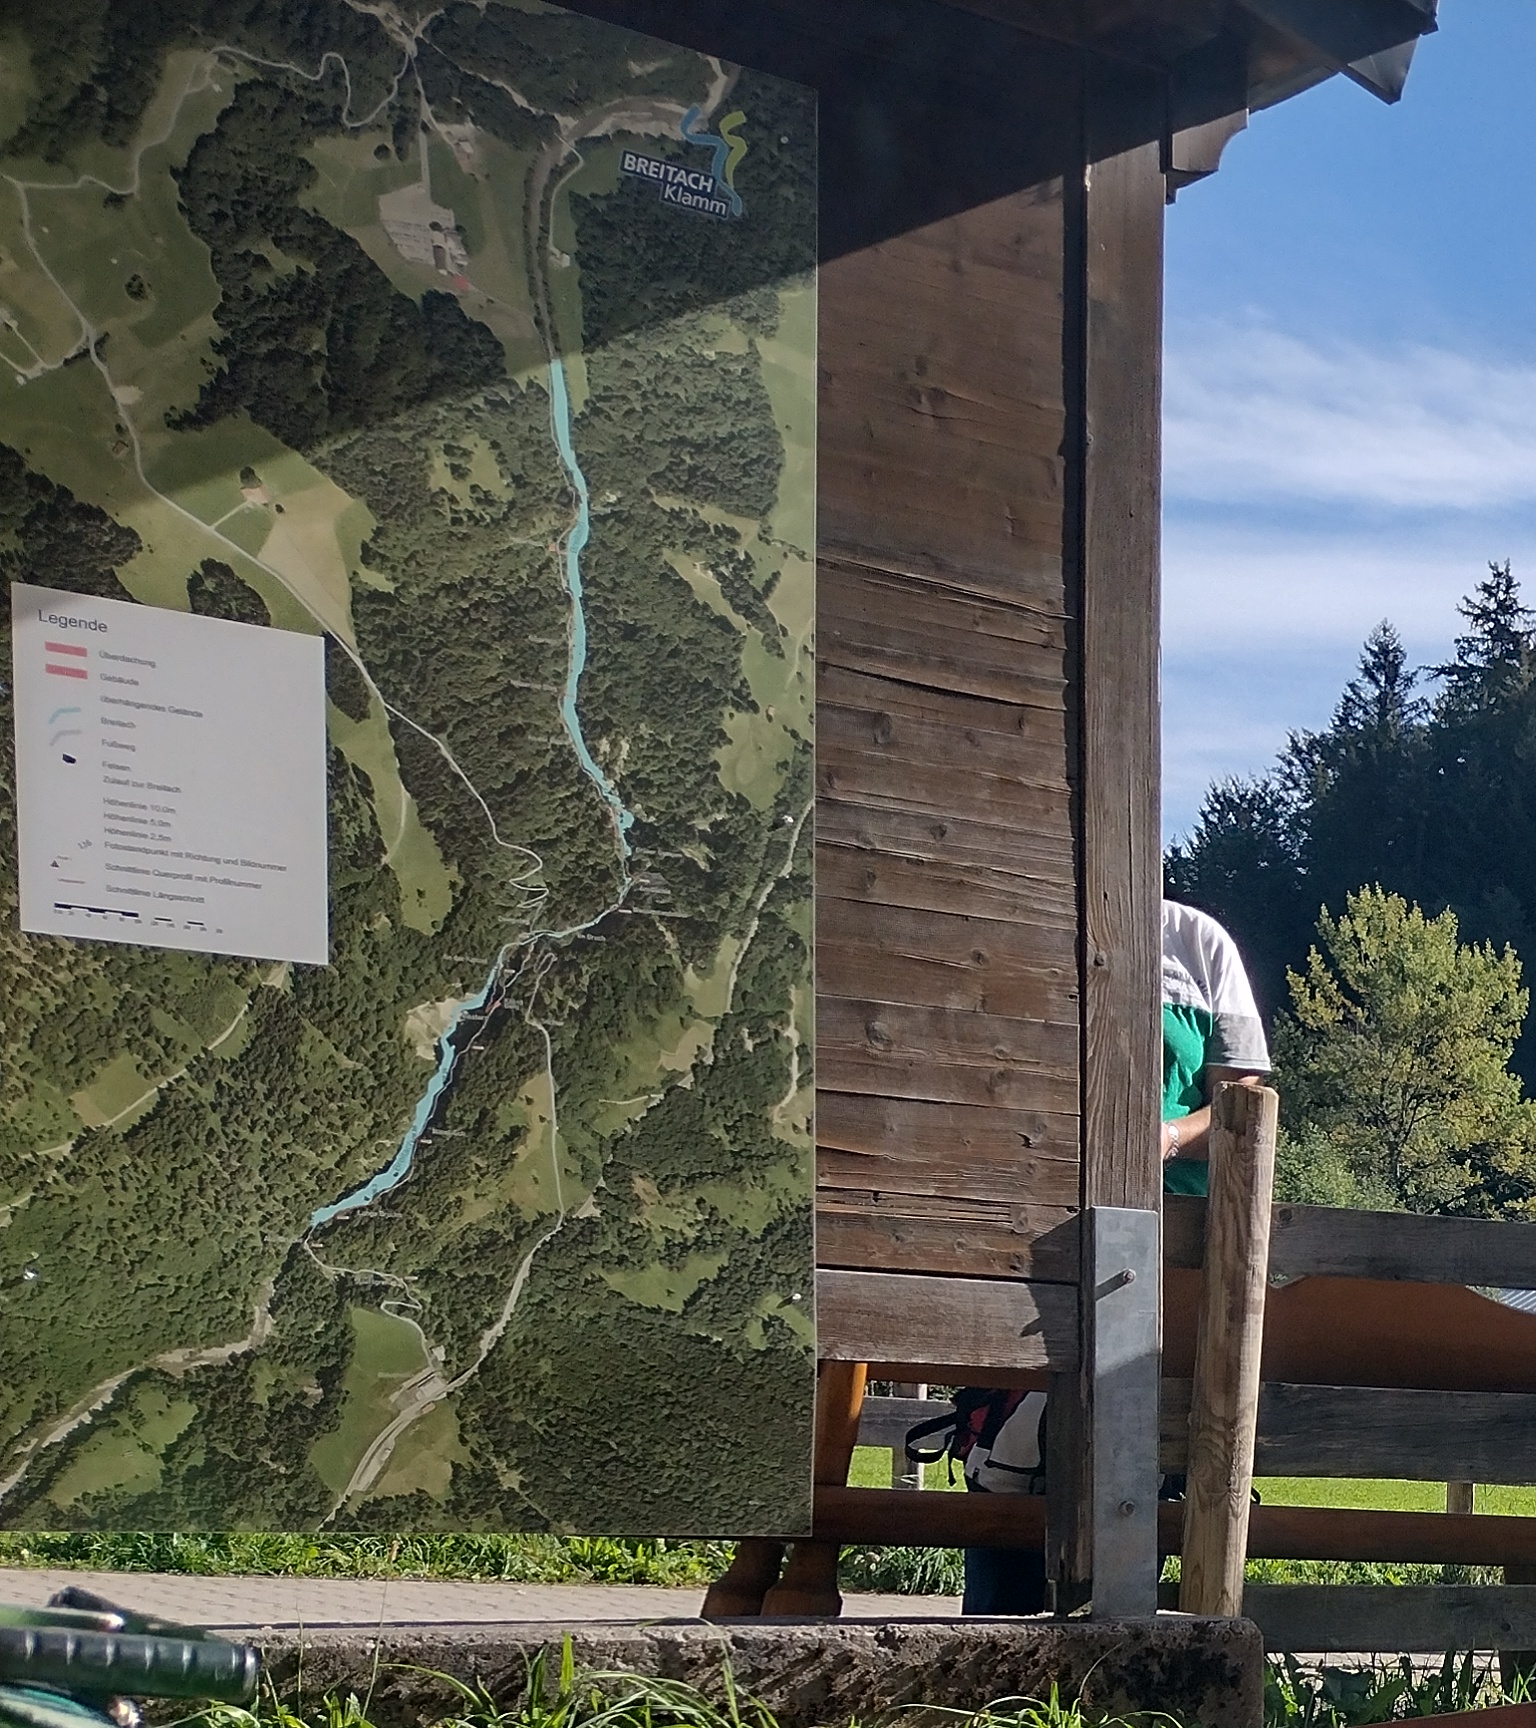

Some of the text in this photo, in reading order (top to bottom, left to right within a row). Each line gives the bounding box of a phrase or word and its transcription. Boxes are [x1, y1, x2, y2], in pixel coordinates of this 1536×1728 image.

[624, 154, 713, 192] BREITACH
[664, 184, 726, 215] Klamm
[38, 609, 108, 633] Legende
[103, 798, 147, 811] Höhenlinie
[104, 812, 148, 825] Höhenlinie
[104, 827, 149, 840] Höhenlinie
[185, 852, 221, 865] Richtung
[223, 858, 238, 867] und
